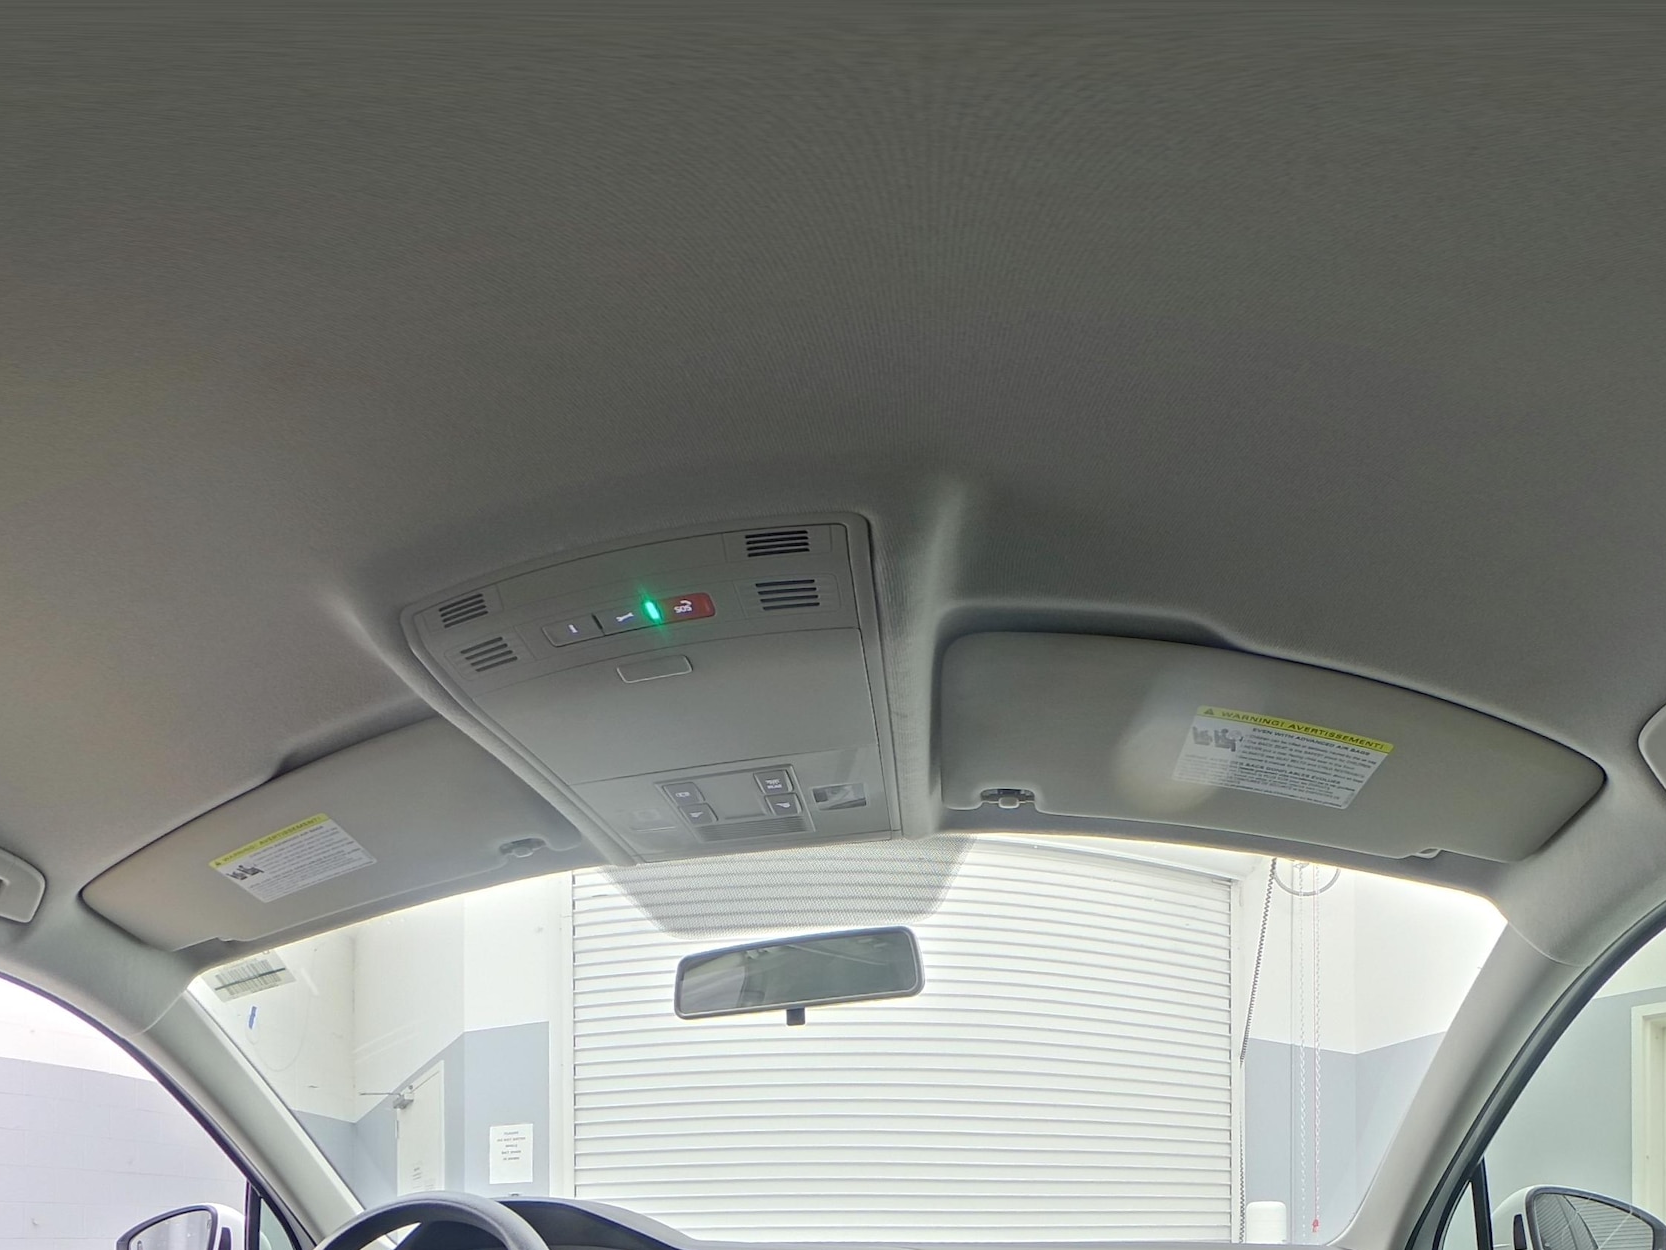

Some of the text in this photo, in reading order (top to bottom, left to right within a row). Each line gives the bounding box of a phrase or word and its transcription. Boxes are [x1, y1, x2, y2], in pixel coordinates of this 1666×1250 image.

[674, 605, 692, 614] SOS
[1221, 711, 1384, 750] WARNING! AVERTISSEMENT!
